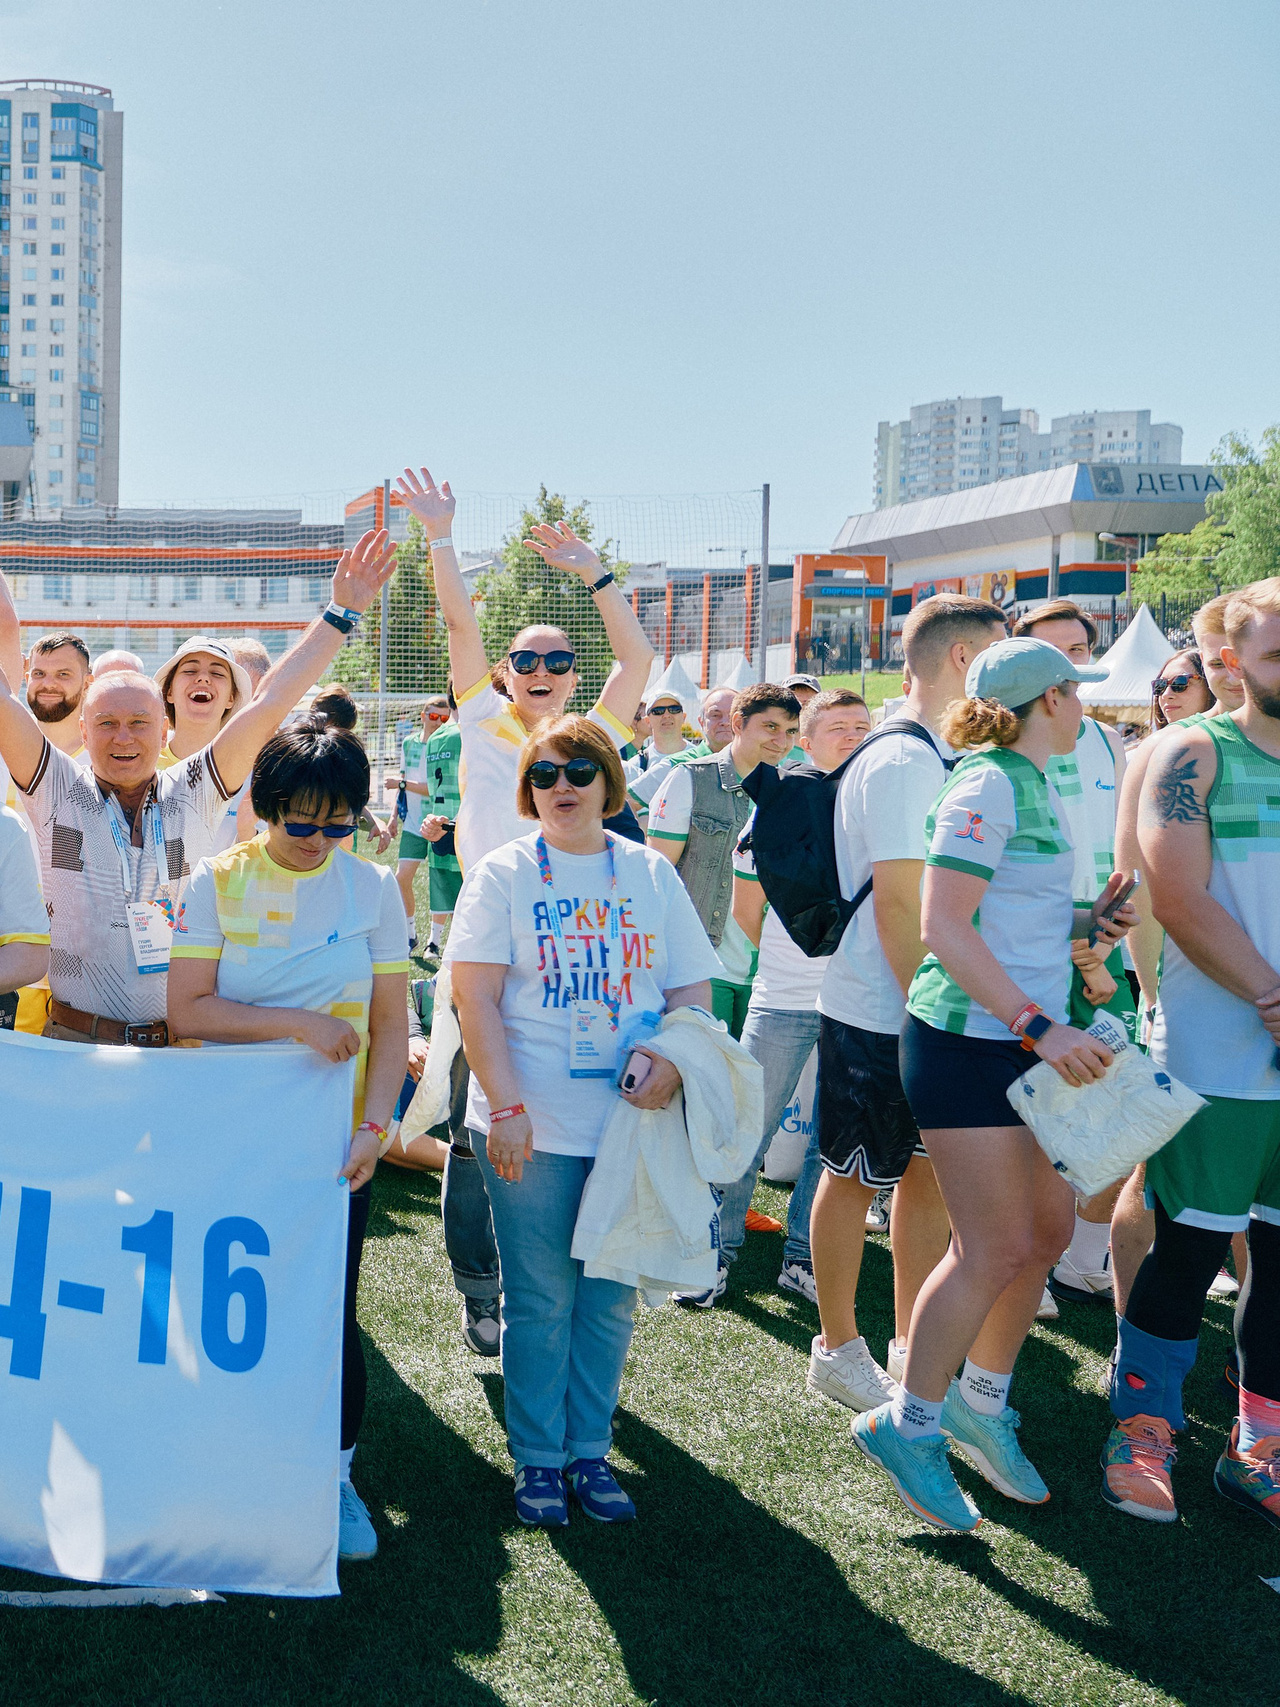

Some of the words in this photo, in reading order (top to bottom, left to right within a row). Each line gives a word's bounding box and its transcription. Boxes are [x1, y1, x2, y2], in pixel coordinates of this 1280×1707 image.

[1136, 473, 1224, 495] ДЕПА
[532, 897, 637, 931] ЯРКИЕ
[977, 1375, 993, 1386] ЗА
[969, 1384, 1001, 1400] ДВИЖ
[908, 1402, 925, 1413] ЗА
